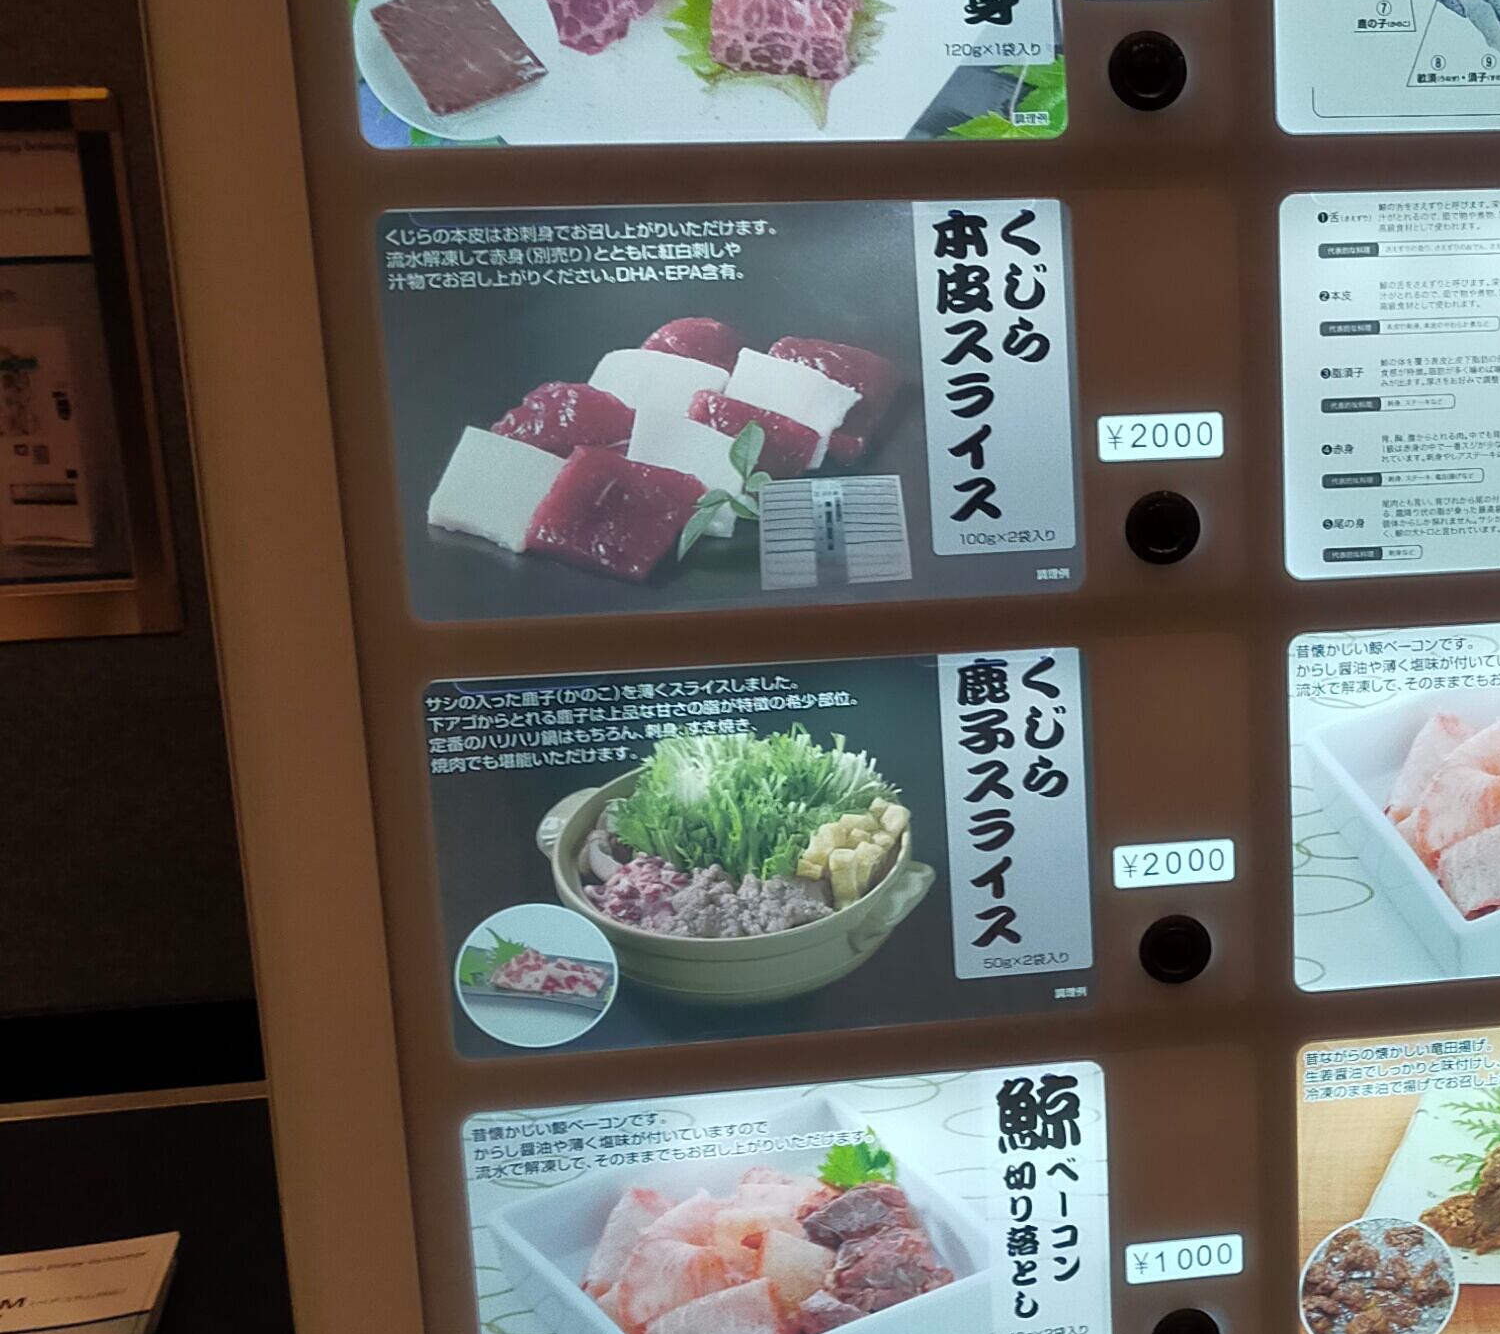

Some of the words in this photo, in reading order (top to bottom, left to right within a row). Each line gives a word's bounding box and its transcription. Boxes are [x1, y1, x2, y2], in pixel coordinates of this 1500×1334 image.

[385, 219, 778, 246] くじらの本皮はお刺身でお召し上がりいただけます。
[1000, 209, 1051, 363] くじら
[932, 209, 1003, 522] 本皮スライス
[1105, 421, 1213, 450] ¥2000
[427, 691, 858, 733] 下アゴからとれる鹿子は上品な甘さの脂が特徴の希少部位。
[1022, 656, 1069, 798] くじら
[430, 746, 638, 774] 焼肉でも堪能いただけます。
[957, 658, 1022, 948] 鹿子スライス
[1122, 848, 1225, 878] ¥2000
[1305, 1038, 1492, 1066] 昔ながらの懐かしい竜田揚げ。
[996, 1073, 1082, 1154] 鯨
[474, 1121, 768, 1161] からし醤油や薄く塩味が付いていますので
[1003, 1161, 1041, 1319] 切り落とし
[1046, 1157, 1080, 1282] ベーコン
[1133, 1243, 1233, 1275] ¥1000
